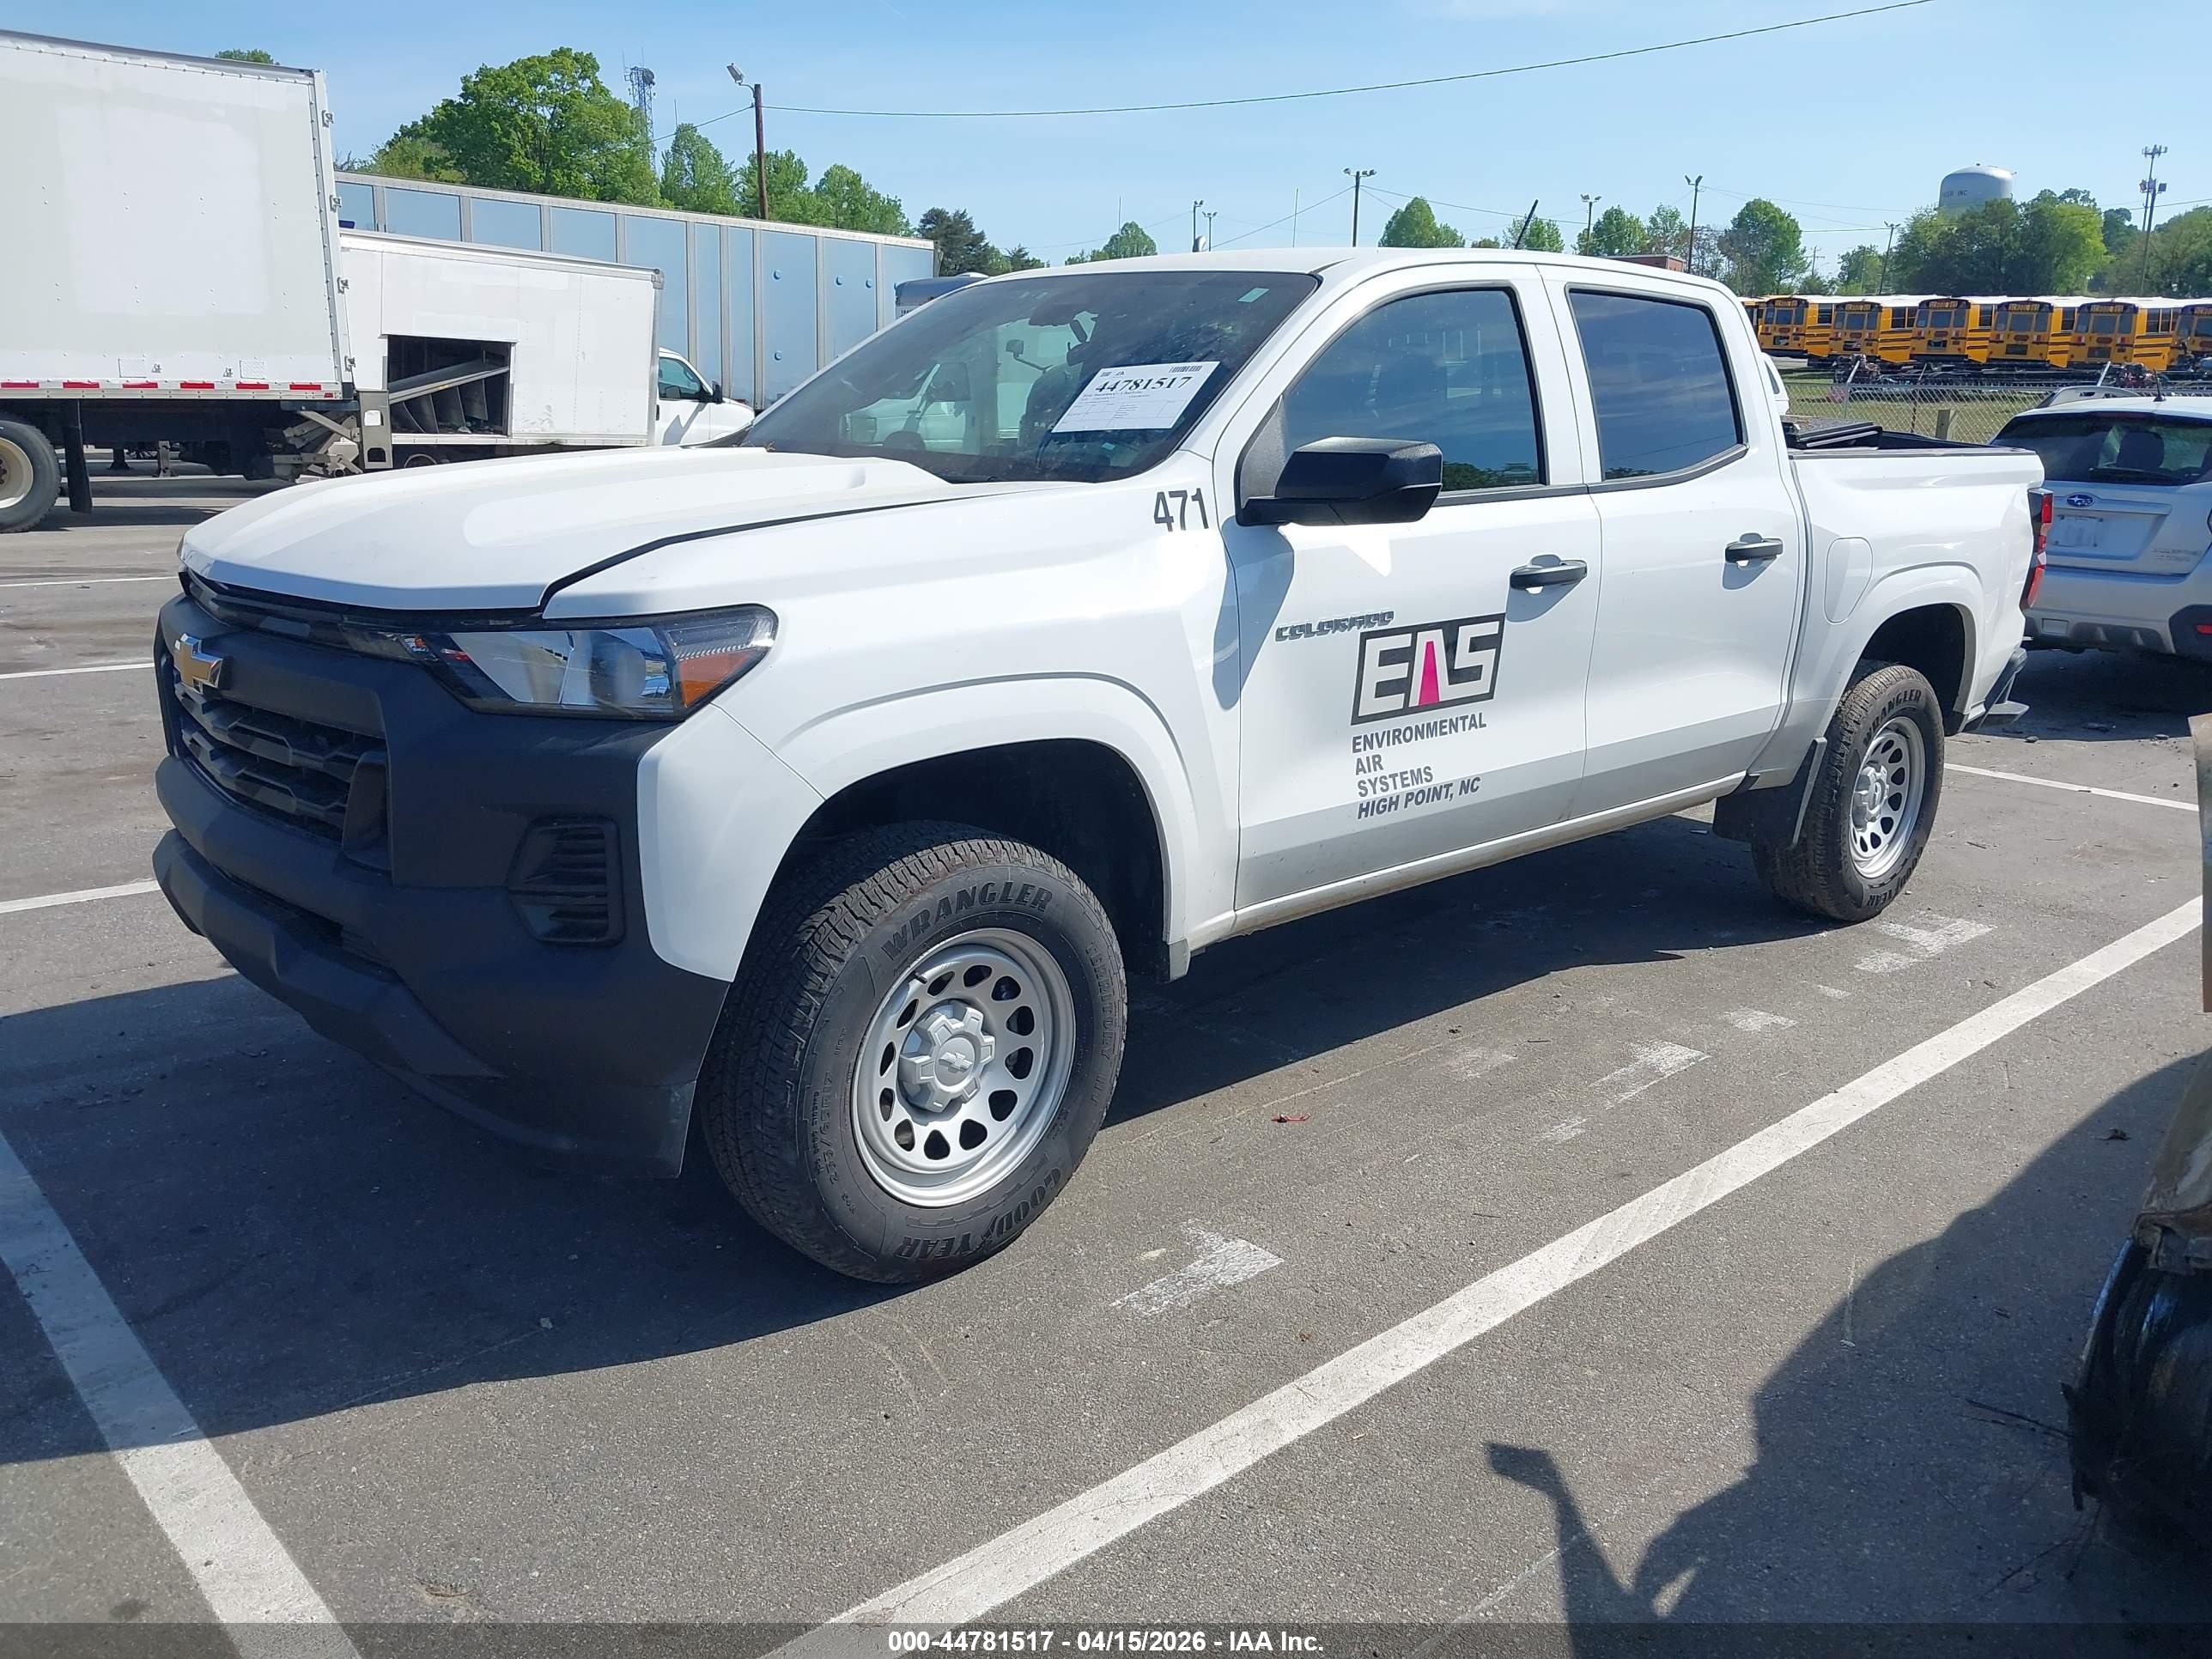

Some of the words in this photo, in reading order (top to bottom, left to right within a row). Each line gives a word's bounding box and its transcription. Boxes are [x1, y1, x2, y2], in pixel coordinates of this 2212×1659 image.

[1095, 376, 1194, 392] 44781517
[1153, 487, 1210, 532] 471
[1275, 611, 1395, 642] COLORADO
[1358, 621, 1501, 717] EAS
[1352, 712, 1487, 754] ENVIRONMENTAL
[1354, 754, 1384, 776] AIR
[1357, 766, 1433, 799] SYSTEMS
[1357, 795, 1399, 819] HIGH
[1403, 782, 1454, 809] POINT,
[1458, 776, 1481, 795] NC
[880, 881, 1053, 961] WRANGLER
[894, 1168, 1061, 1259] GOODYEAR
